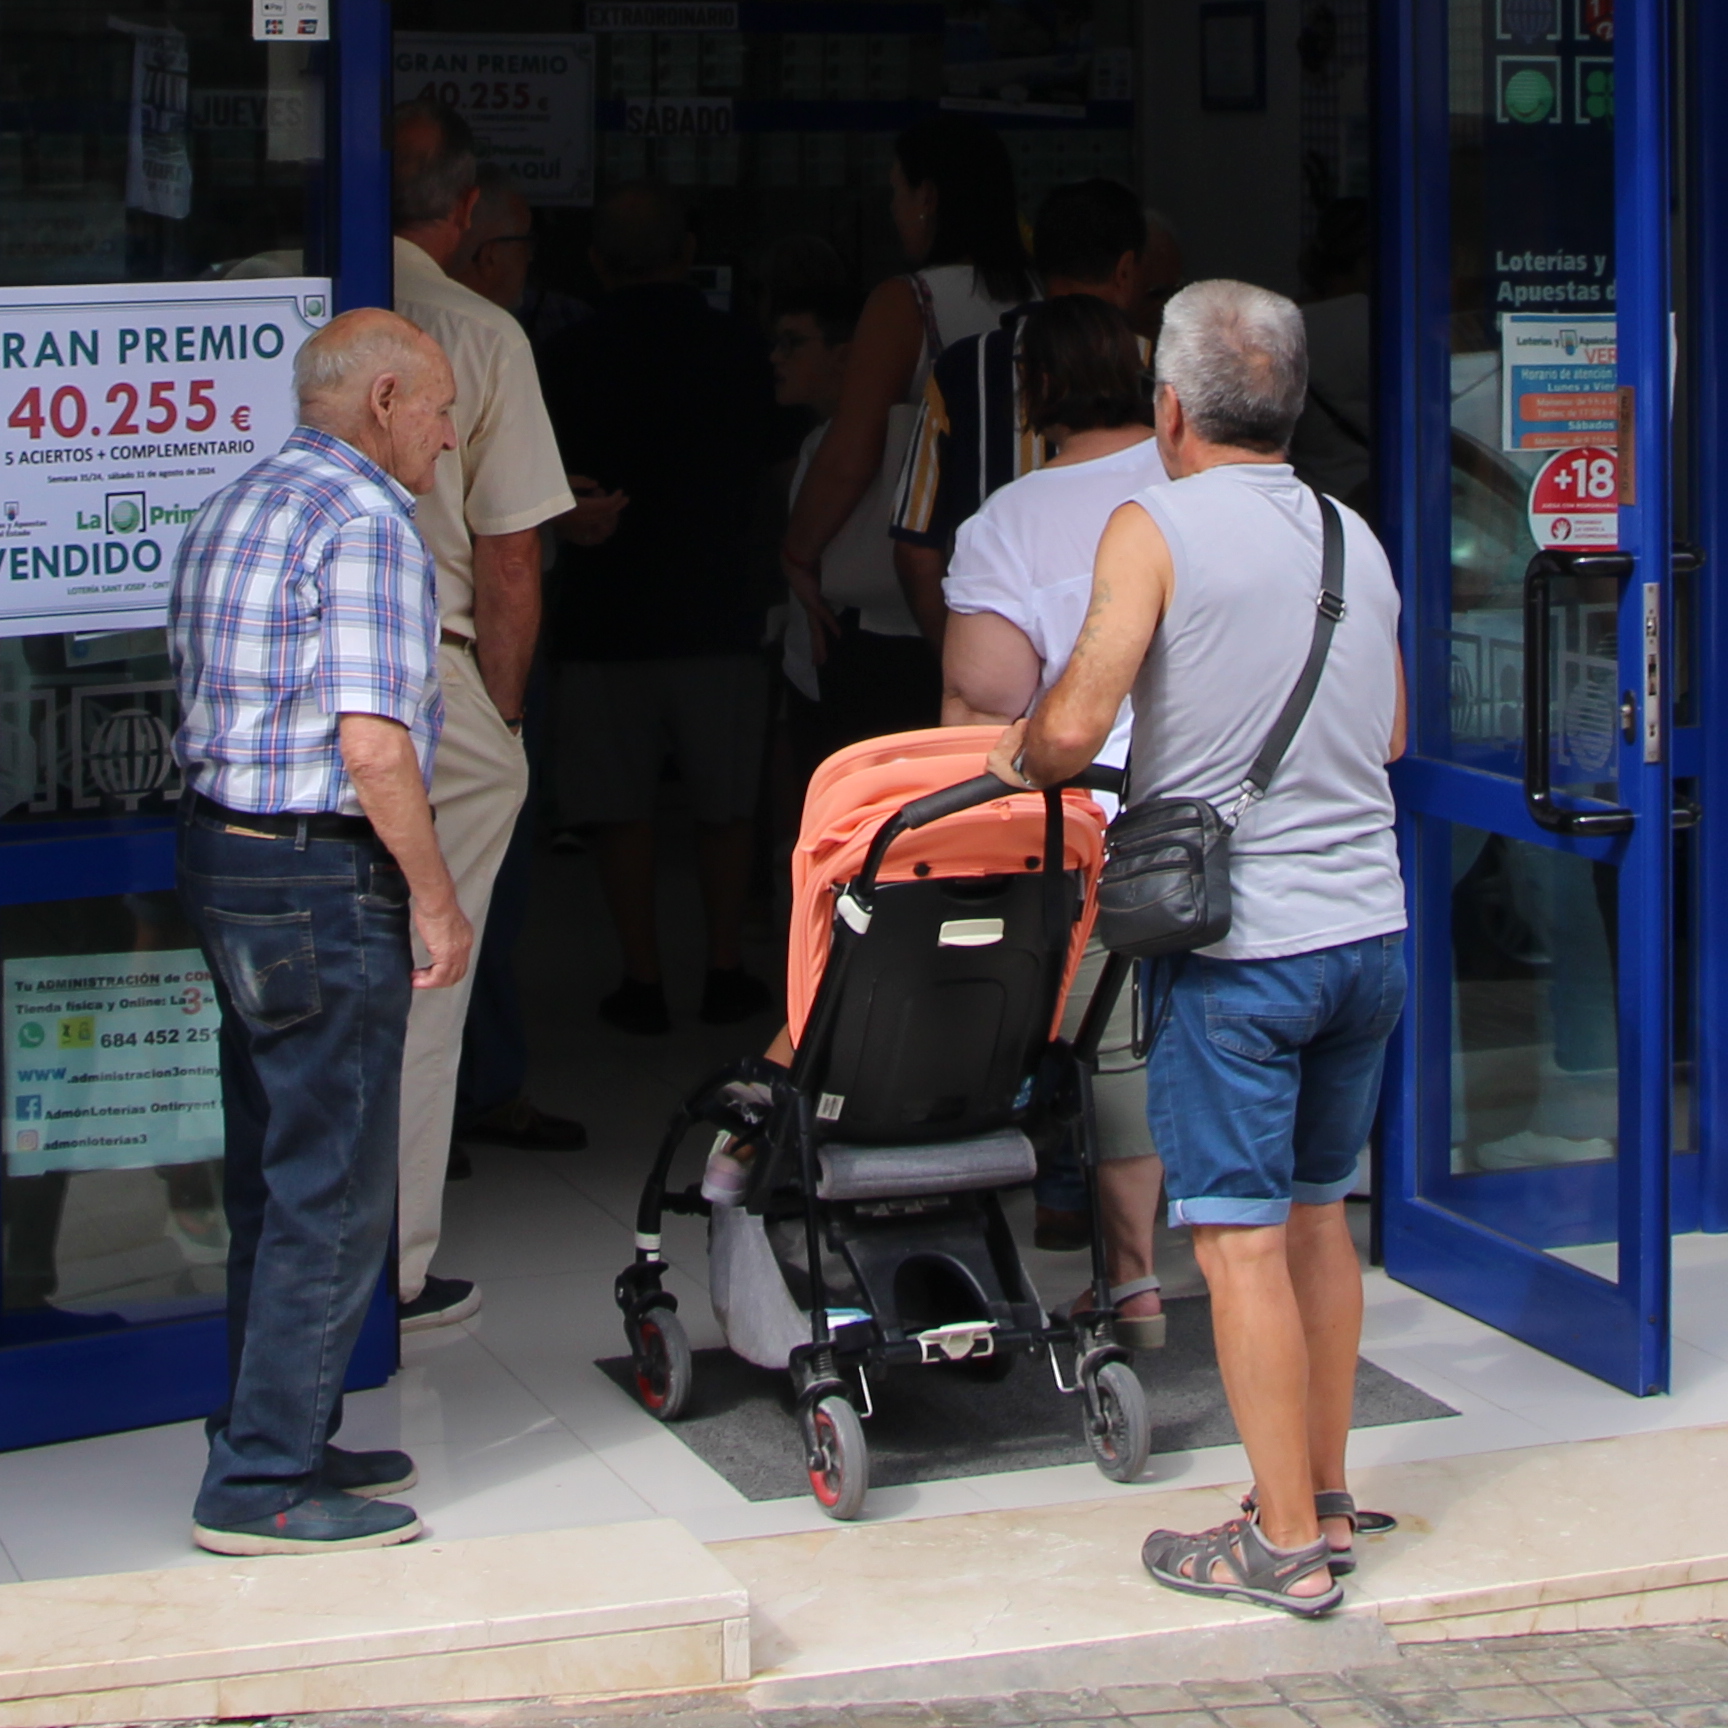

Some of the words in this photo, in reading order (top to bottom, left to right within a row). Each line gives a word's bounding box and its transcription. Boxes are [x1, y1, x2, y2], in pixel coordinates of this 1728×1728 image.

[1496, 249, 1587, 272] Loterías
[1595, 255, 1607, 276] y
[1497, 281, 1601, 307] Apuestas
[119, 322, 285, 364] PREMIO
[1593, 382, 1616, 391] Vier
[7, 379, 218, 439] 40.255
[230, 405, 251, 431] €
[5, 451, 14, 466] 5
[18, 448, 93, 465] ACIERTOS
[110, 439, 255, 461] COMPLEMENTARIO
[1553, 458, 1615, 499] +18
[76, 511, 101, 530] La
[15, 981, 33, 992] Tu
[36, 973, 160, 992] ADMINISTRACIÓN
[164, 974, 180, 983] de
[15, 1003, 62, 1015] Tienda
[107, 1001, 117, 1012] y
[118, 998, 166, 1010] Online:
[181, 986, 203, 1016] 3
[100, 1032, 137, 1049] 684
[143, 1029, 180, 1045] 452
[150, 1099, 216, 1114] Ontinyent
